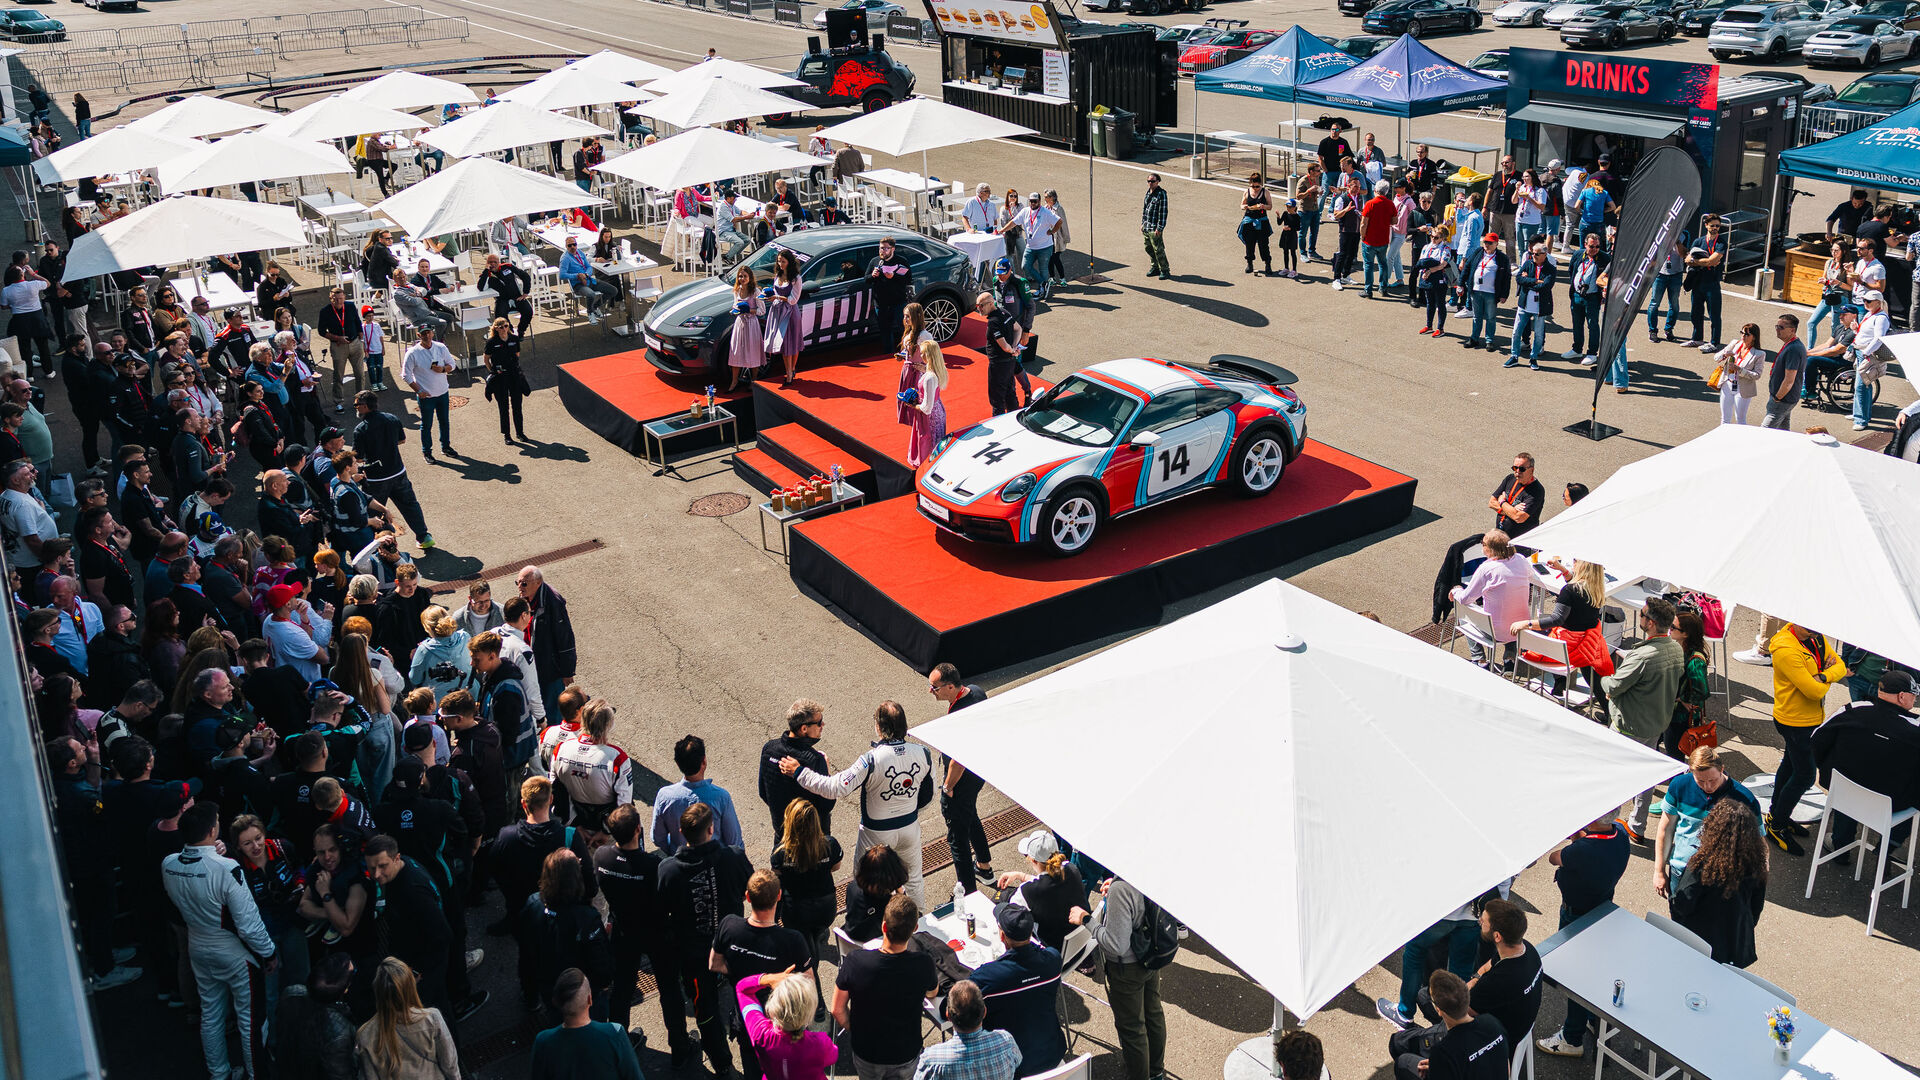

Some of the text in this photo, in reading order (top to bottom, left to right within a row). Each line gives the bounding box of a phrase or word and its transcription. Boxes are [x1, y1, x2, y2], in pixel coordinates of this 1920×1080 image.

[1565, 59, 1650, 95] DRINKS
[1222, 82, 1264, 93] REDBULLRING.COM
[1326, 95, 1374, 107] REDBULLRING.COM
[1443, 93, 1489, 106] REDBULLRING.COM
[1623, 195, 1685, 305] PORSCHE
[971, 441, 1014, 465] 14
[1158, 443, 1190, 482] 14
[559, 757, 608, 770] PORSCHE
[165, 868, 207, 879] PORSCHE
[598, 866, 644, 880] PORSCHE
[1468, 1034, 1503, 1061] GT SPORTS
